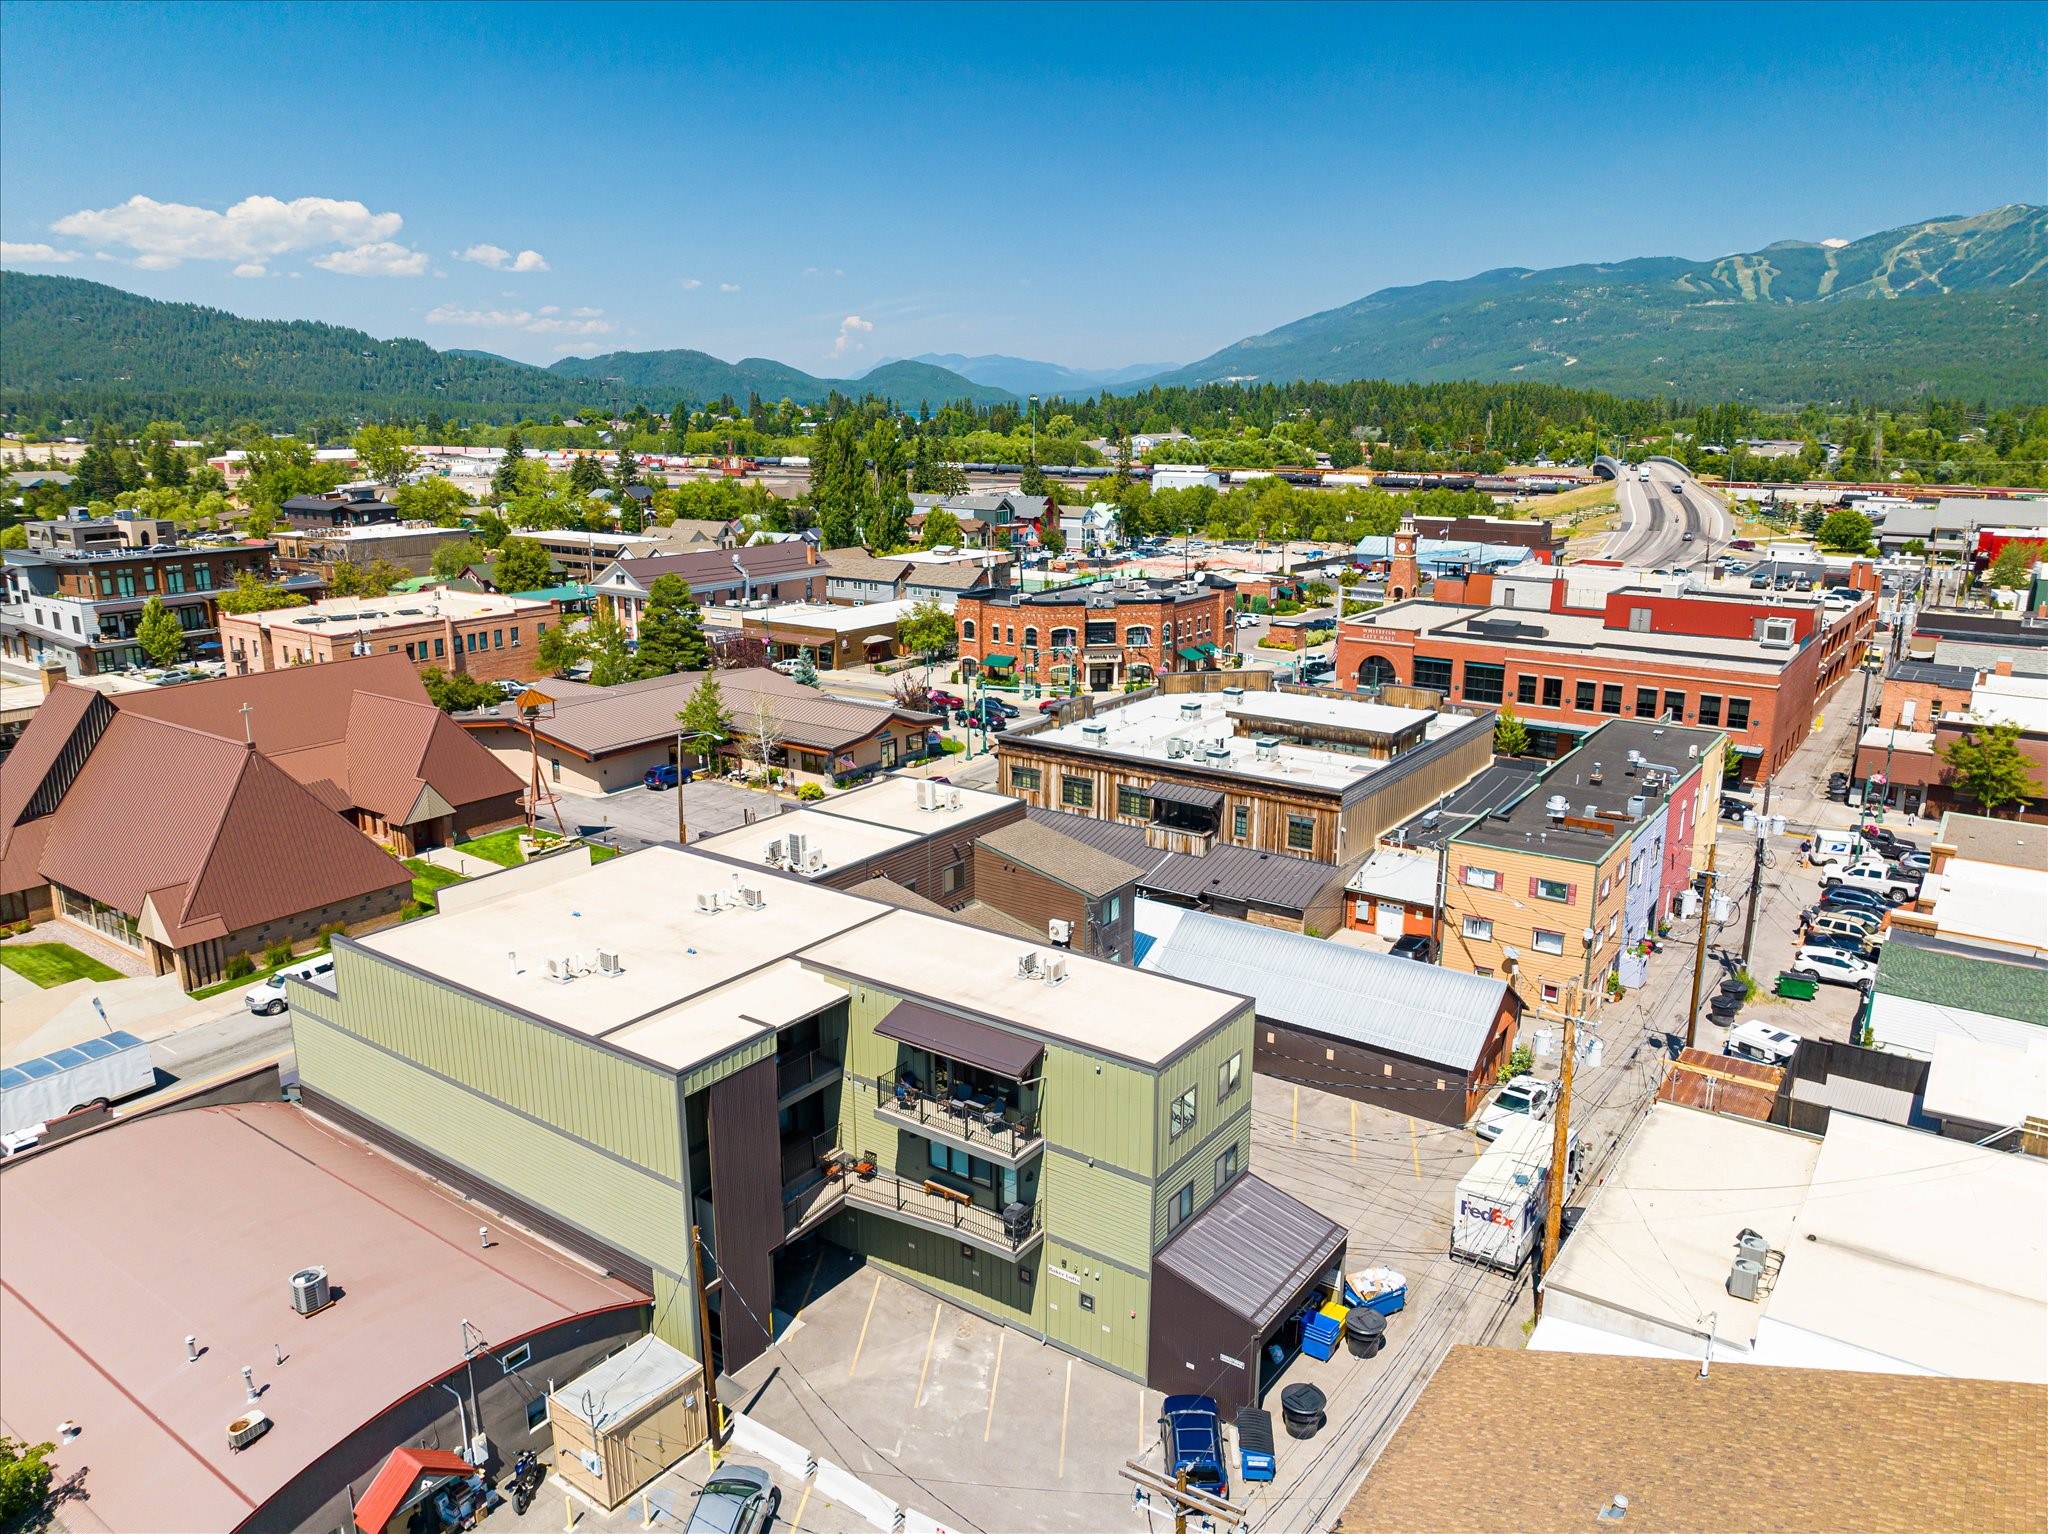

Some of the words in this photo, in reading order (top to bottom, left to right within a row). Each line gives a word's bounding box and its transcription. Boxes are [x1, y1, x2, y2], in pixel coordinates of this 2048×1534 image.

[1362, 628, 1396, 636] WHITEFISH
[1460, 1199, 1515, 1230] FedEx
[1048, 1266, 1065, 1277] Baker
